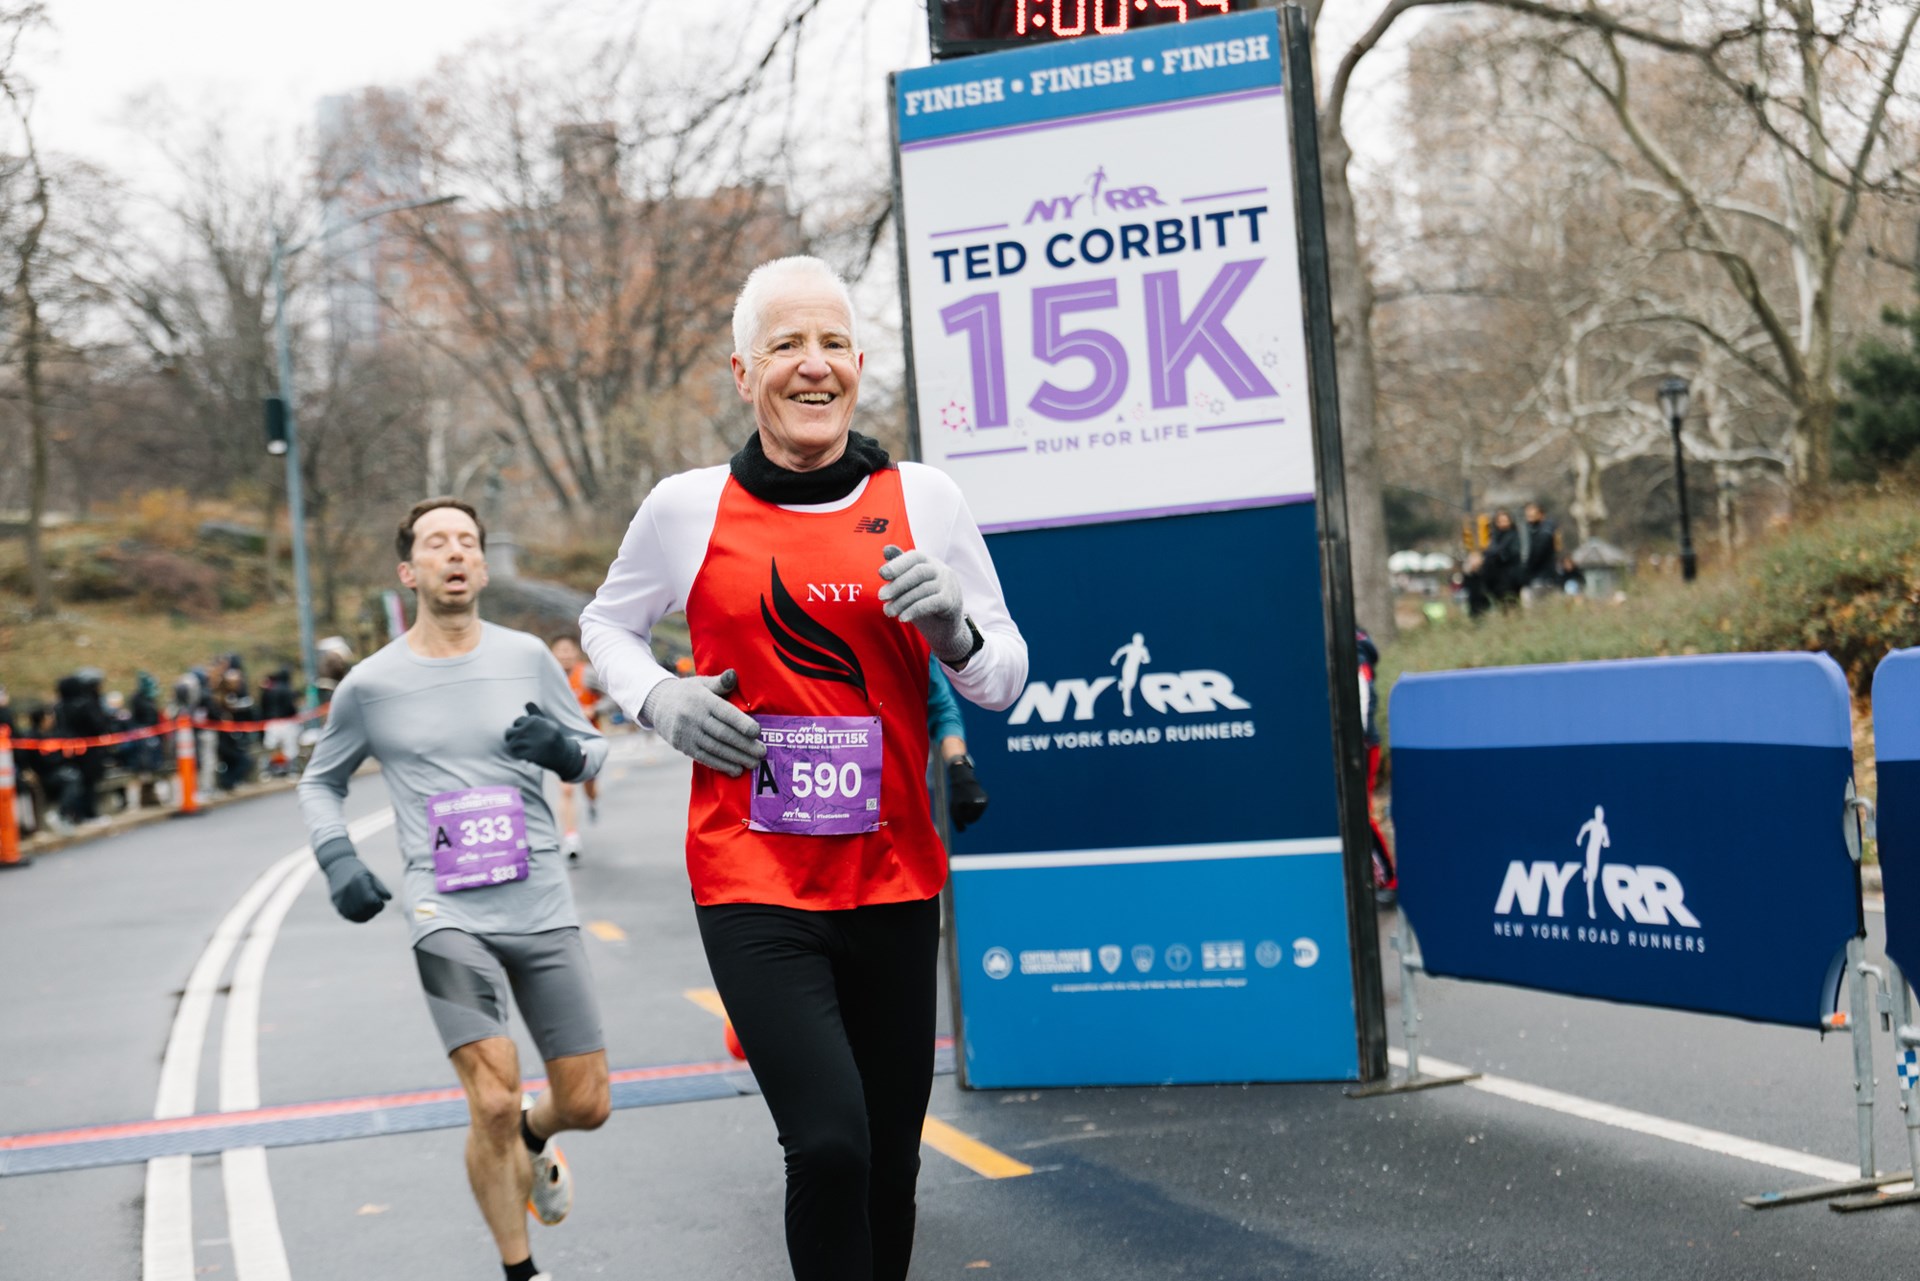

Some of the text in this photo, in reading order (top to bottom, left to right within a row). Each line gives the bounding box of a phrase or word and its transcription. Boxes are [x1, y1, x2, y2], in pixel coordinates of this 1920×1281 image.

[905, 35, 1270, 116] FINISH FINISH FINISH
[933, 206, 1268, 284] TED CORBITT
[939, 256, 1280, 429] 15K
[1035, 424, 1189, 454] RUN FOR LIFE
[807, 584, 862, 602] NYF
[761, 731, 784, 742] TED
[1008, 721, 1255, 752] NEW YORK ROAD RUNNERS
[757, 759, 779, 795] A
[791, 762, 862, 798] 590
[435, 815, 514, 850] A 333
[1494, 922, 1705, 953] NEW YORK ROAD RUNNERS
